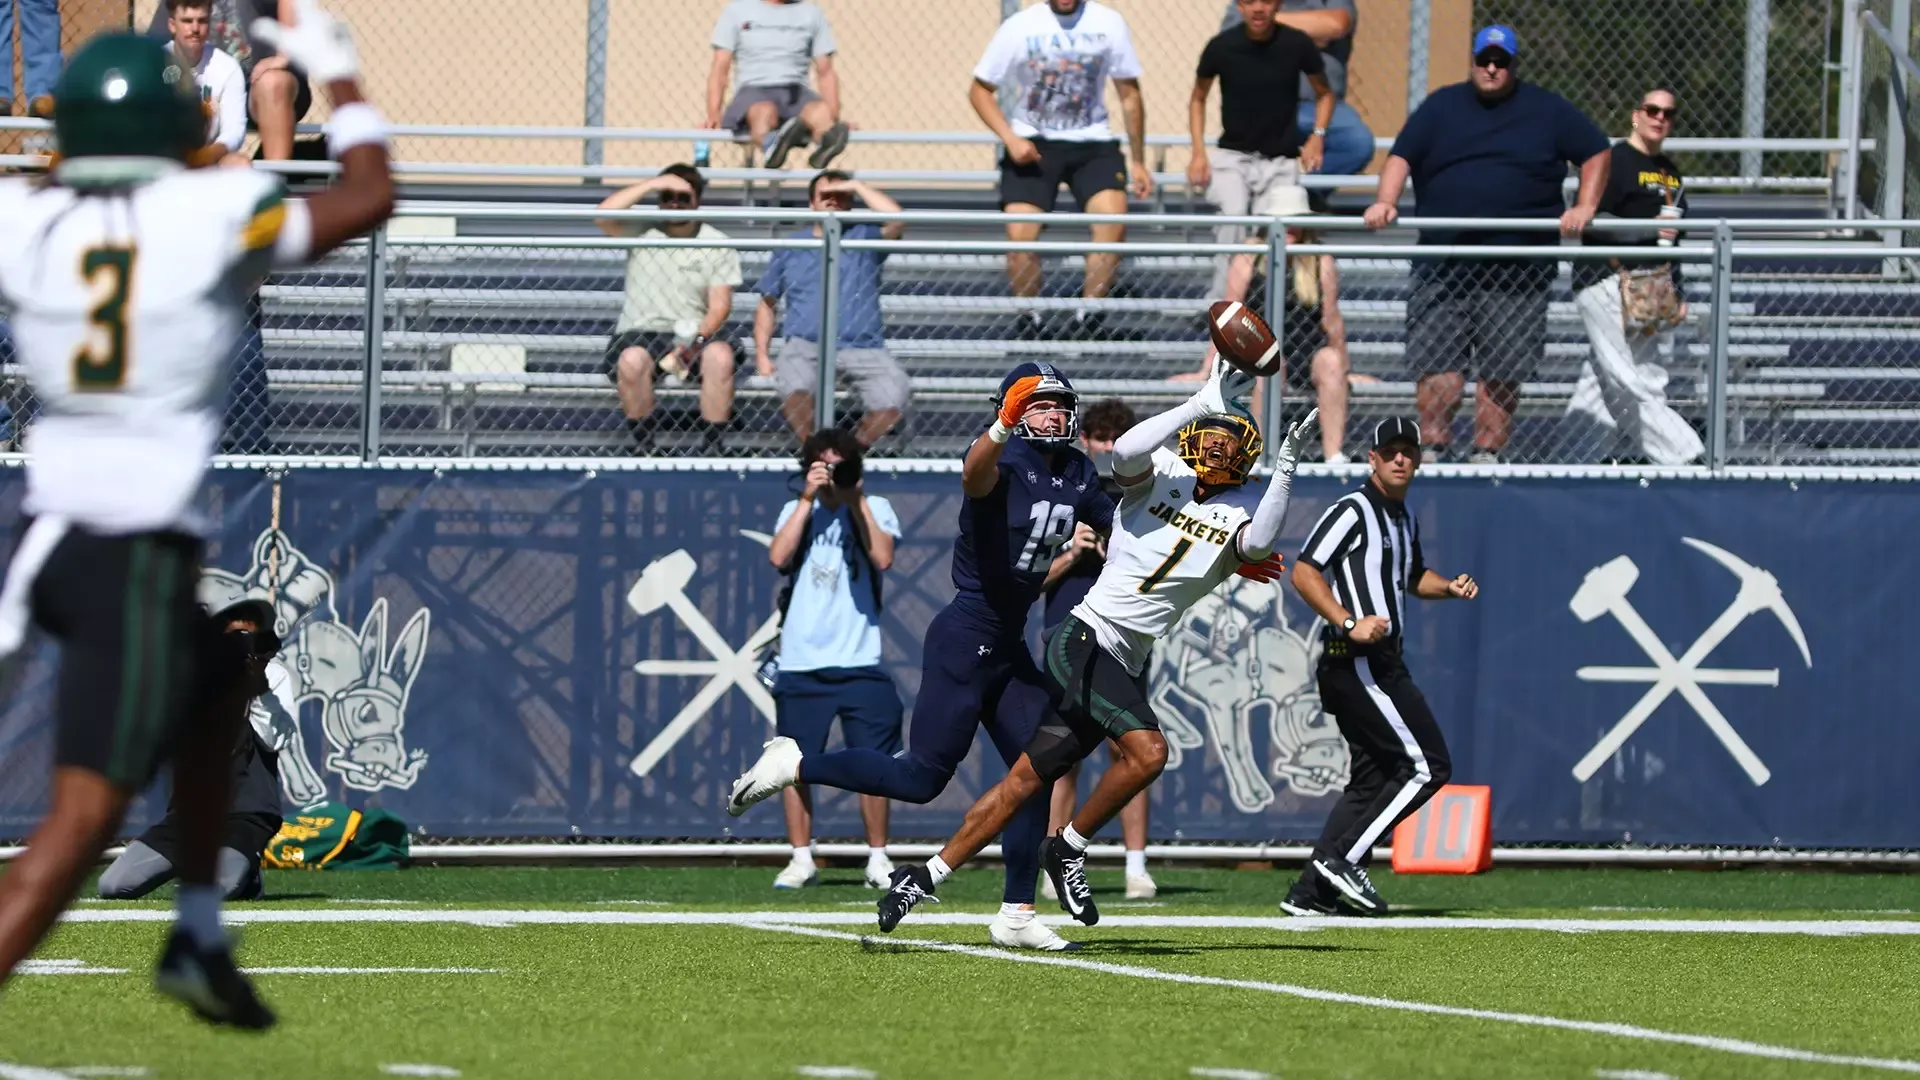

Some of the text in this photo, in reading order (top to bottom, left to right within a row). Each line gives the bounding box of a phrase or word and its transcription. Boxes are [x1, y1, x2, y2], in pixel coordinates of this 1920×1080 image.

[72, 245, 136, 391] 3
[1014, 500, 1075, 573] 19
[1148, 501, 1230, 546] JACKETS
[1137, 535, 1195, 595] 1
[1411, 794, 1475, 859] 10
